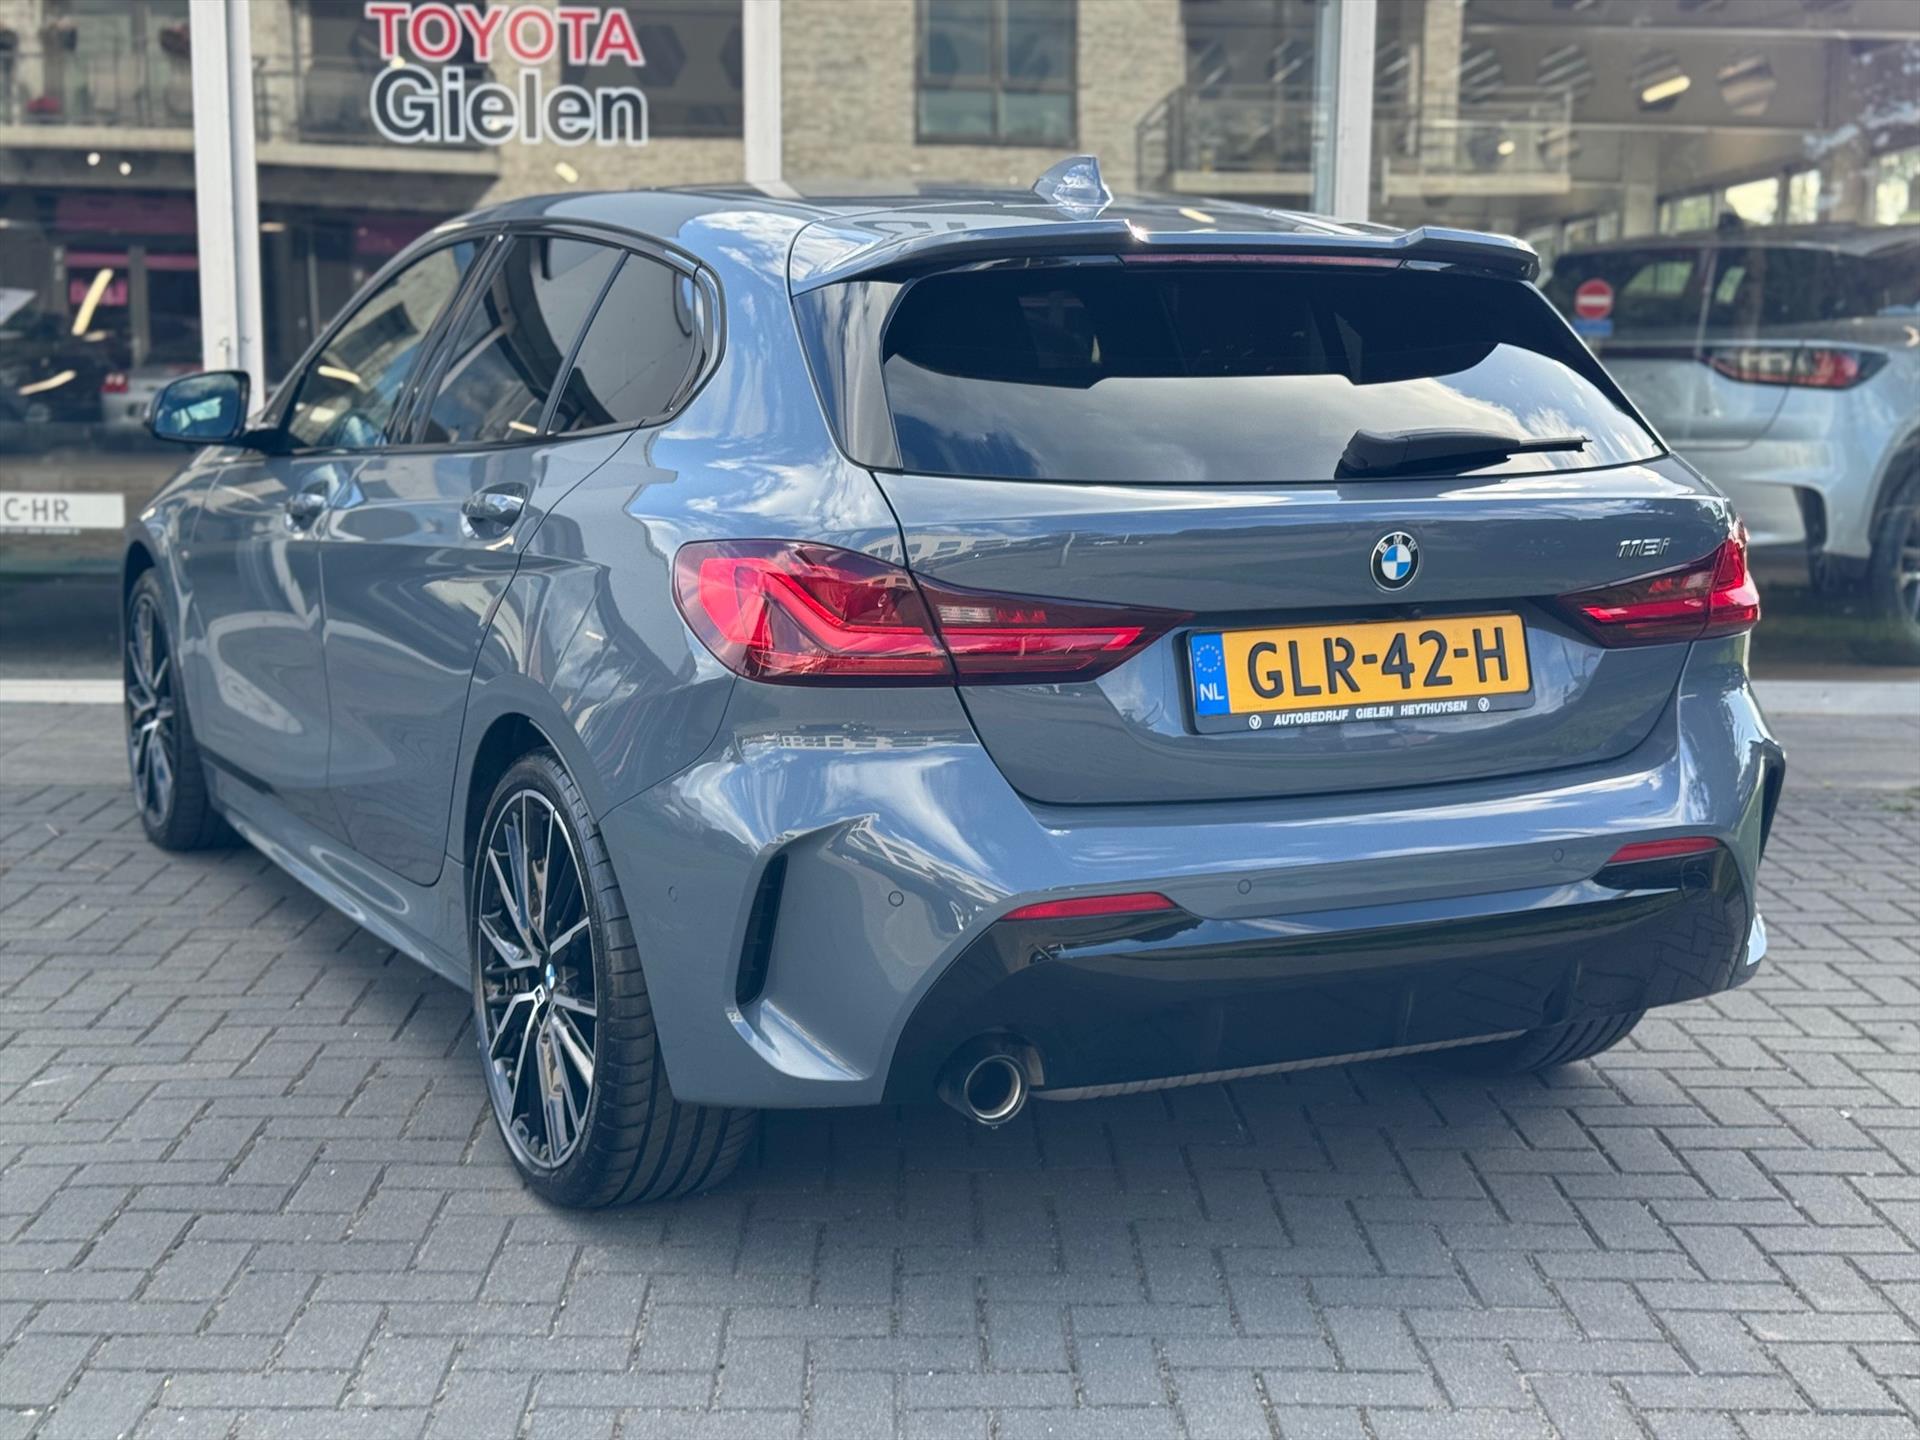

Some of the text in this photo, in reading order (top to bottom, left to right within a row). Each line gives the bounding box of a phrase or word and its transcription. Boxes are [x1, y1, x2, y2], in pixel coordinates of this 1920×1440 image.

[366, 3, 645, 66] TOYOTA
[370, 63, 648, 146] Gielen
[3, 497, 71, 522] C-HR
[1377, 534, 1418, 554] BMW
[1247, 626, 1509, 699] GLR-42-H
[1200, 682, 1225, 701] NL
[1273, 700, 1468, 726] AUTOBEDRIJF GIELEN HEYTHUYSEN
